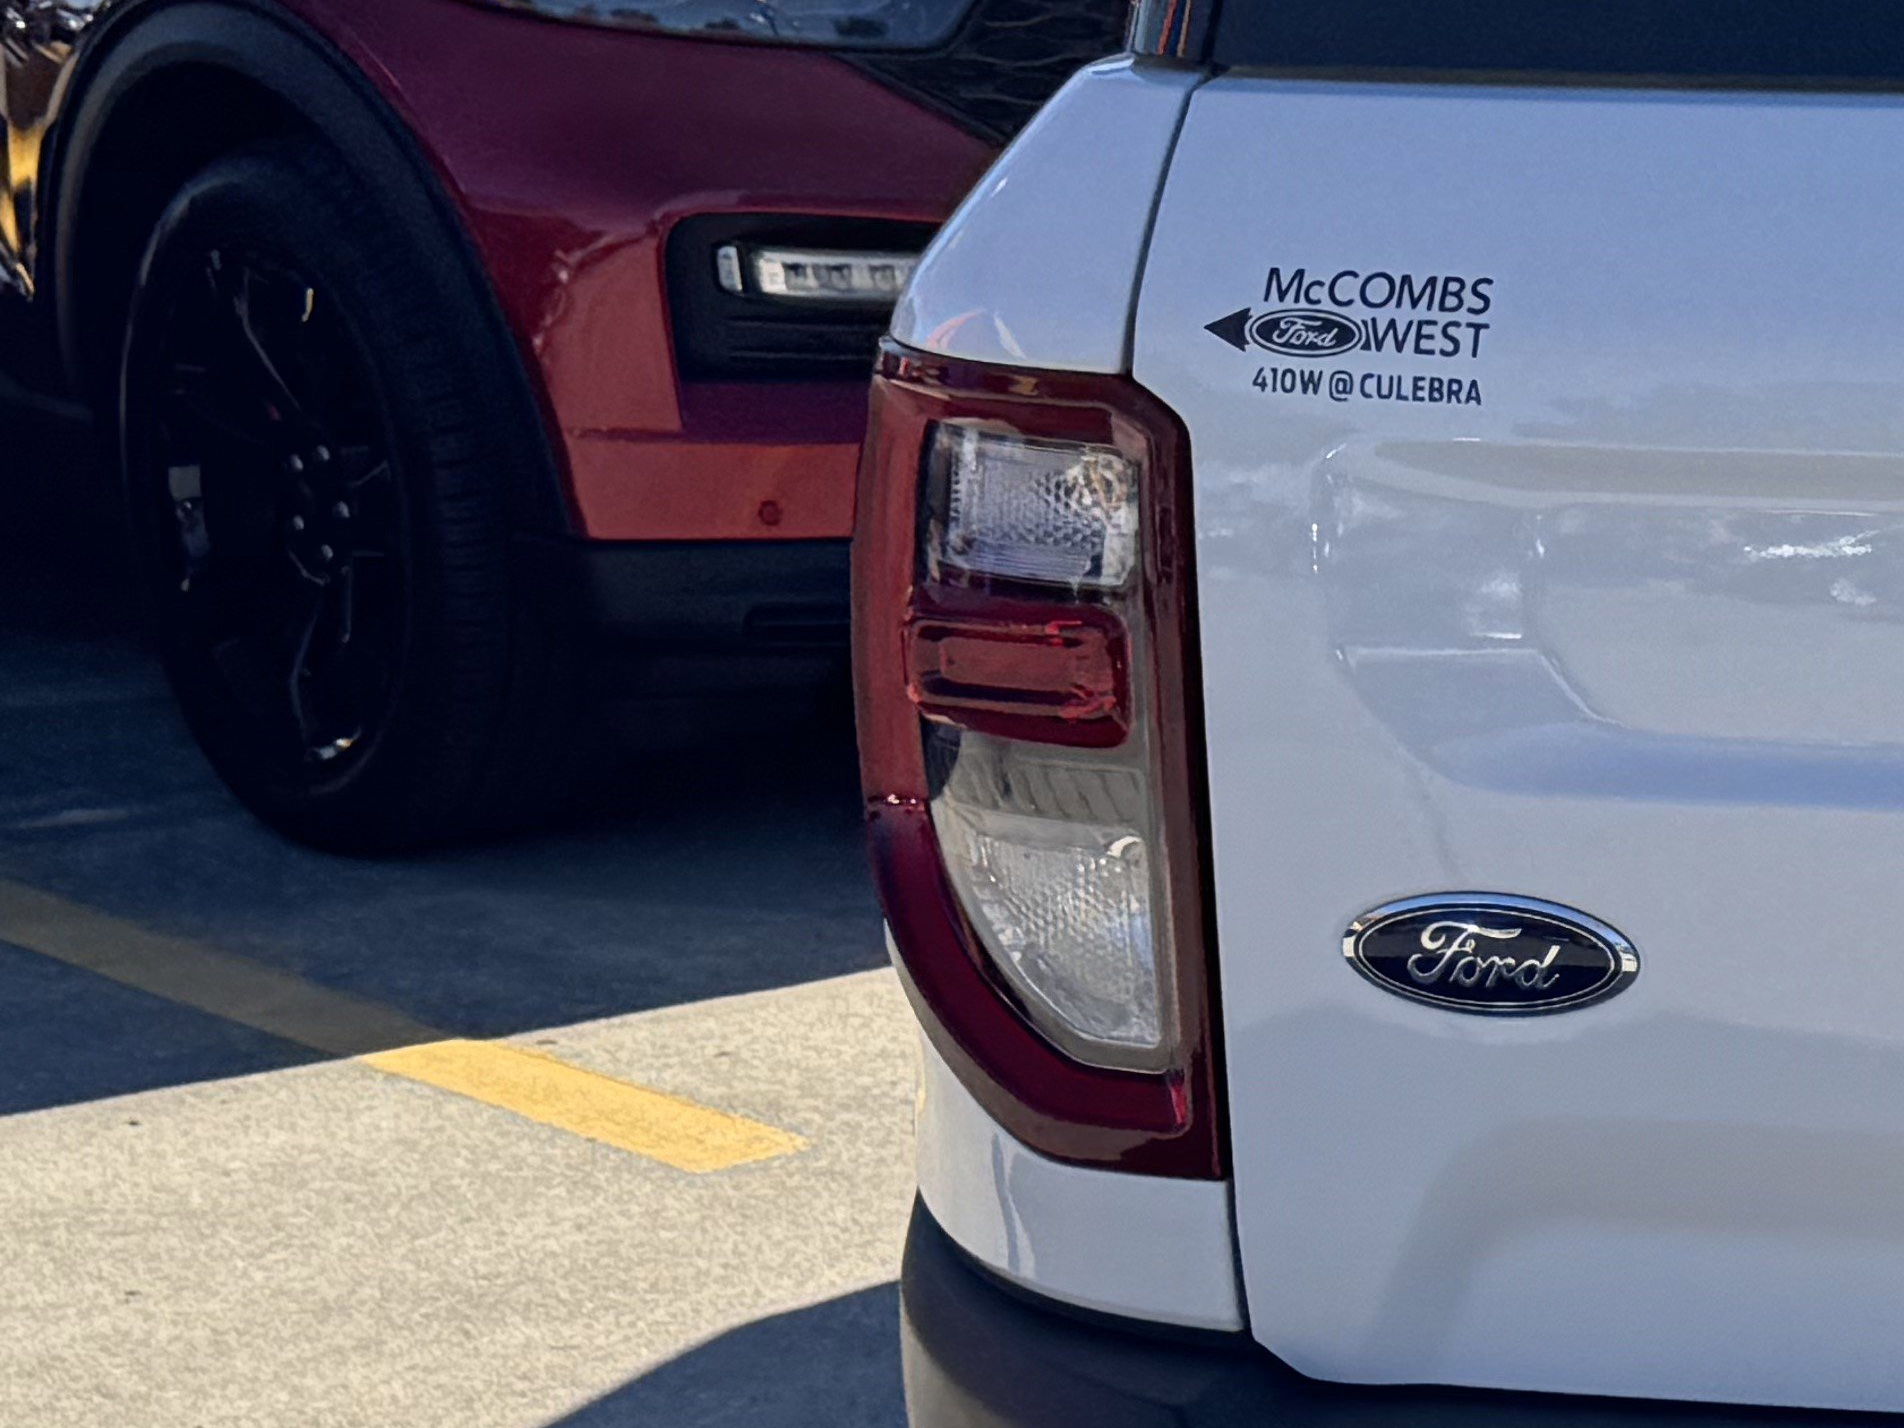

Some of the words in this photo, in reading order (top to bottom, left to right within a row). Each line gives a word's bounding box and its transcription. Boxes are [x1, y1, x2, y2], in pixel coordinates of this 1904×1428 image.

[1263, 267, 1494, 315] McCOMBS
[1272, 316, 1339, 348] Ford
[1370, 316, 1490, 358] WEST
[1359, 372, 1482, 406] CULEBRA
[1407, 920, 1560, 988] Ford
